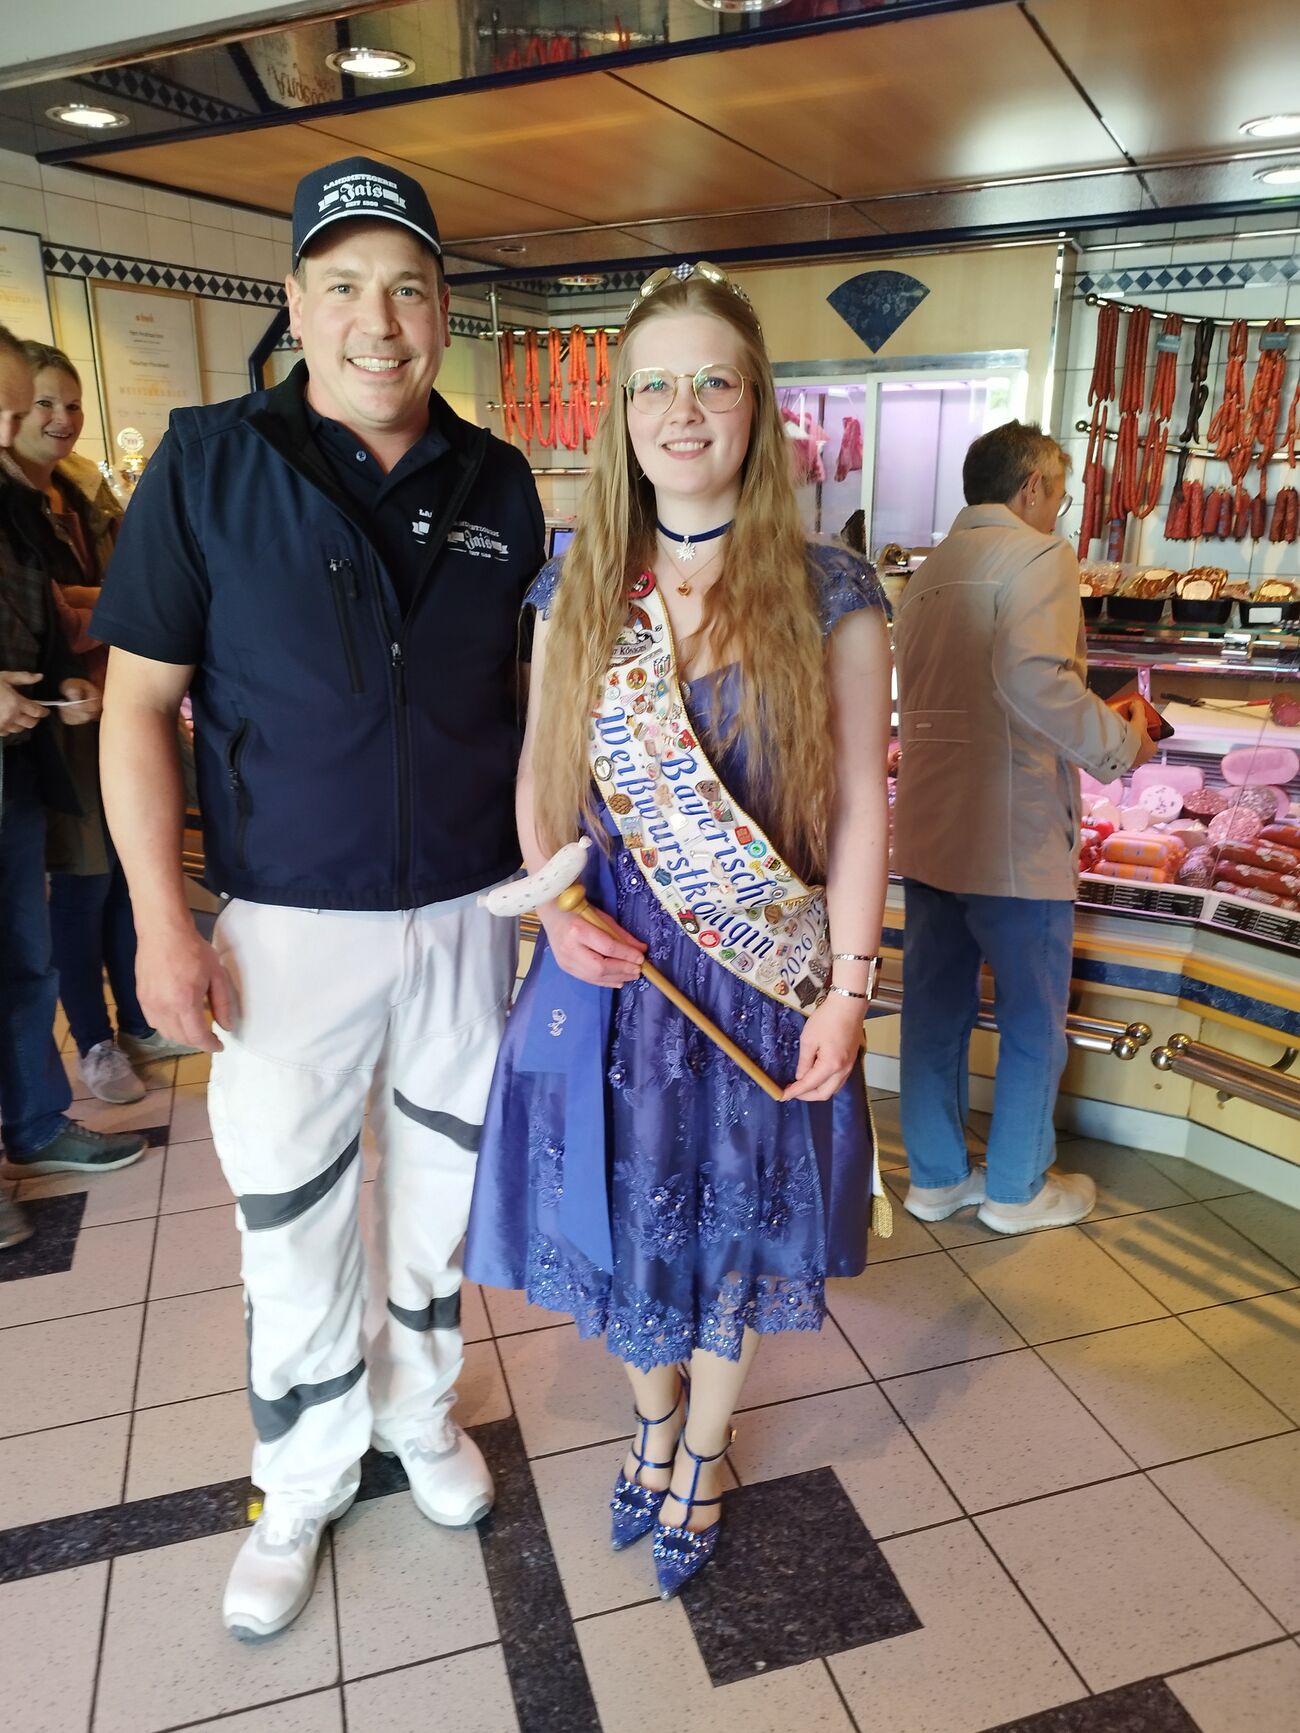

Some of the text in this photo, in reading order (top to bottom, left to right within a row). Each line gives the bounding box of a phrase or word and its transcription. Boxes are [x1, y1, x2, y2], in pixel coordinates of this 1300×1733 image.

[340, 181, 383, 203] Jais
[595, 706, 775, 959] Weißwurstkönigin
[660, 752, 778, 908] Bayerische
